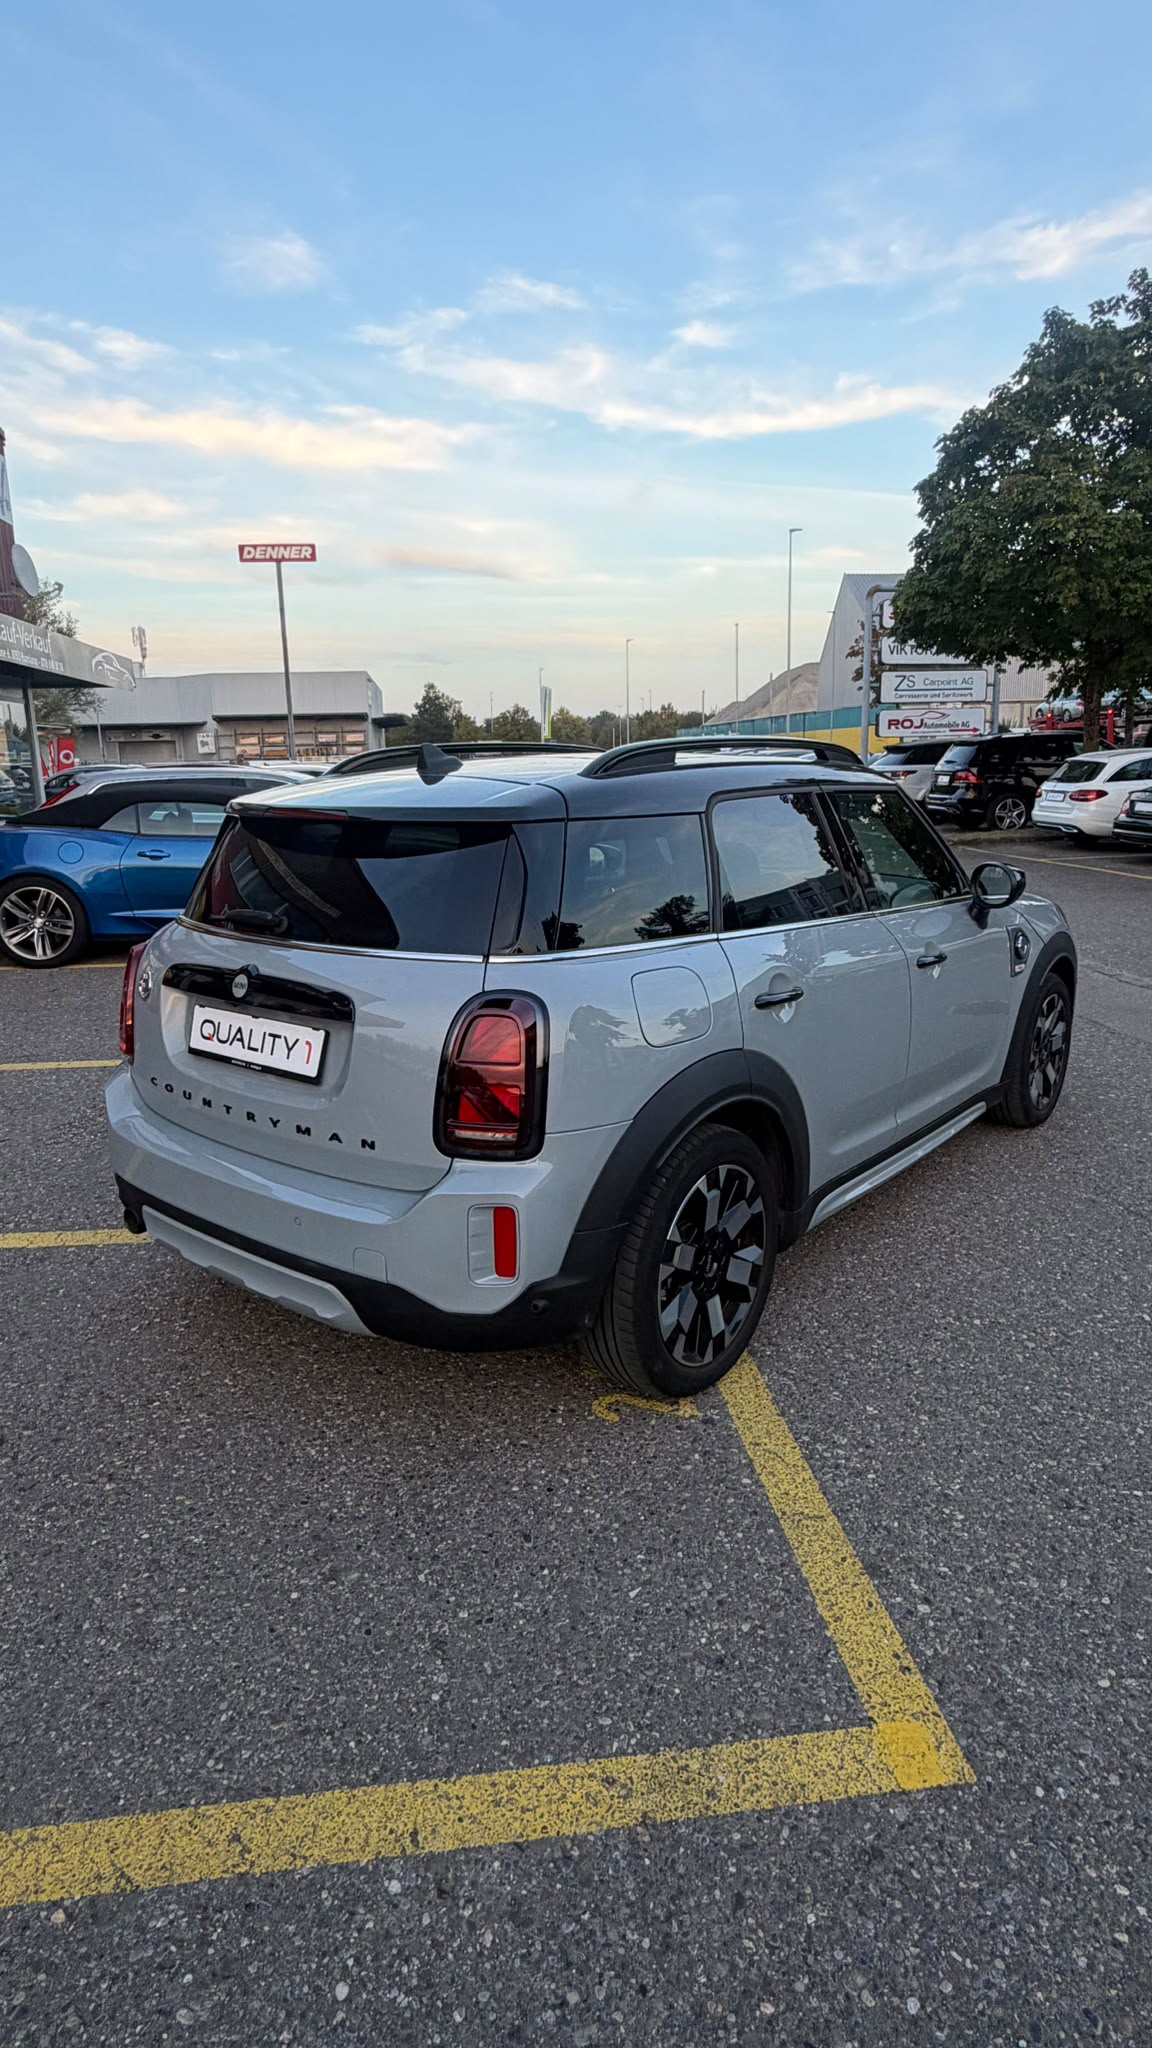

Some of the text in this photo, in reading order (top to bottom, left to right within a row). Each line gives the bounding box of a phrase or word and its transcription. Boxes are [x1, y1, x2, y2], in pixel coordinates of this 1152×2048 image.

[243, 546, 312, 560] DENNER
[0, 621, 52, 653] auf-Verkauf
[923, 678, 958, 687] Carpoint
[960, 677, 974, 685] AG
[888, 719, 924, 730] ROJ
[924, 721, 959, 729] Automobile
[200, 1018, 312, 1064] QUALITY 1
[150, 1076, 376, 1151] COUNTRYMAN
